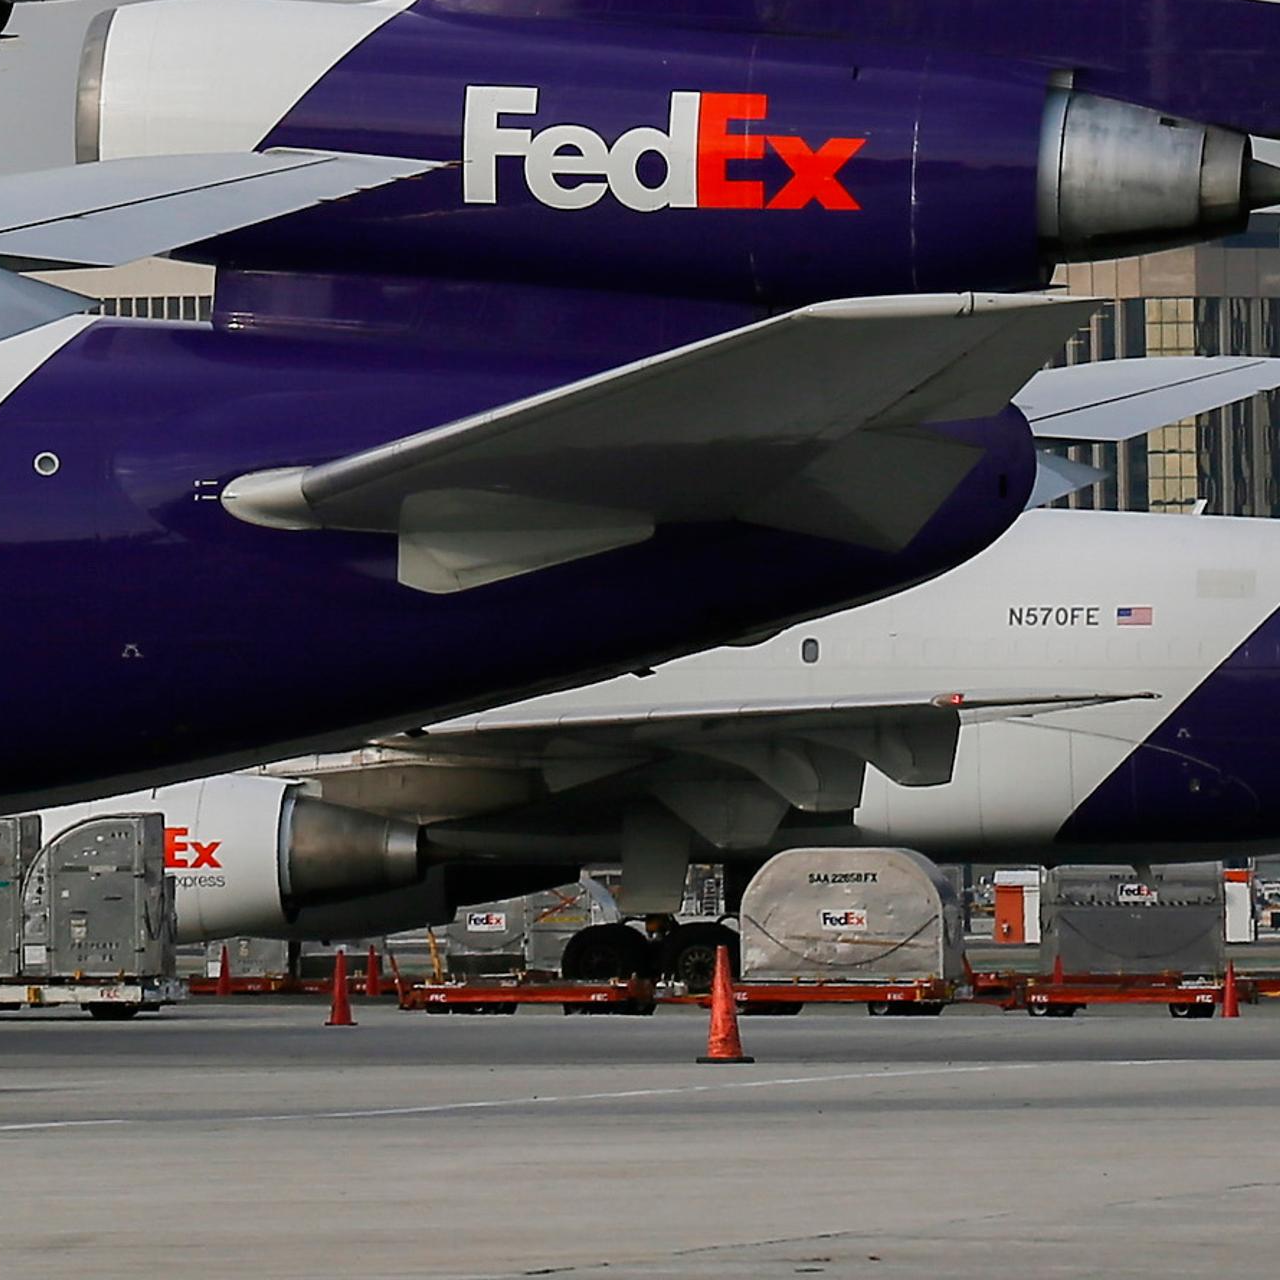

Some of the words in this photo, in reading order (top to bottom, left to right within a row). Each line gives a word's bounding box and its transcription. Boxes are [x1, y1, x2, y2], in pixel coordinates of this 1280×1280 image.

[463, 85, 866, 212] FedEx
[1008, 607, 1100, 626] N570FE
[163, 826, 223, 868] Ex
[174, 874, 226, 888] xpress
[808, 873, 829, 884] SAA
[864, 872, 878, 883] FX
[469, 913, 504, 926] FedEx
[822, 912, 865, 926] FedEx
